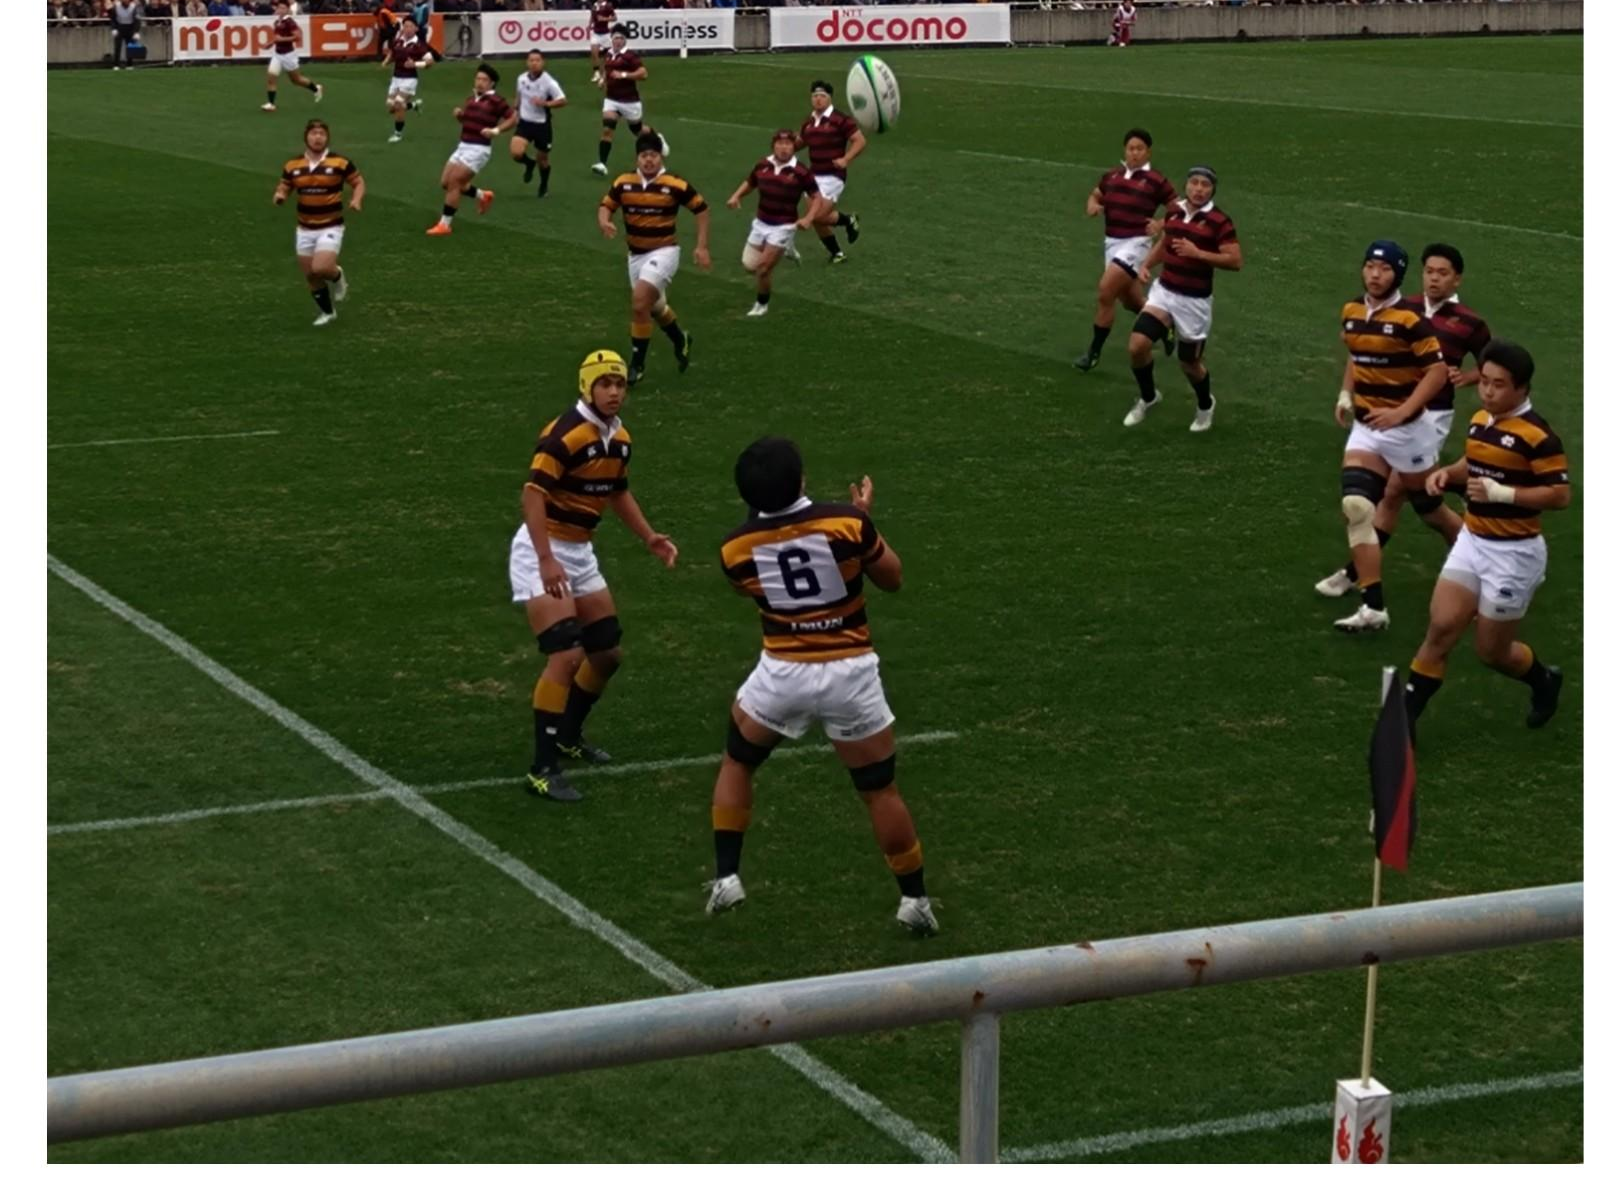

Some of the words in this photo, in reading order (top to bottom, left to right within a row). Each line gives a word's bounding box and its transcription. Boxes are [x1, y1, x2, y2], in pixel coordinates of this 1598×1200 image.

[816, 9, 967, 43] docomo
[842, 8, 863, 17] NTT
[626, 20, 718, 40] Business
[777, 547, 822, 599] 6
